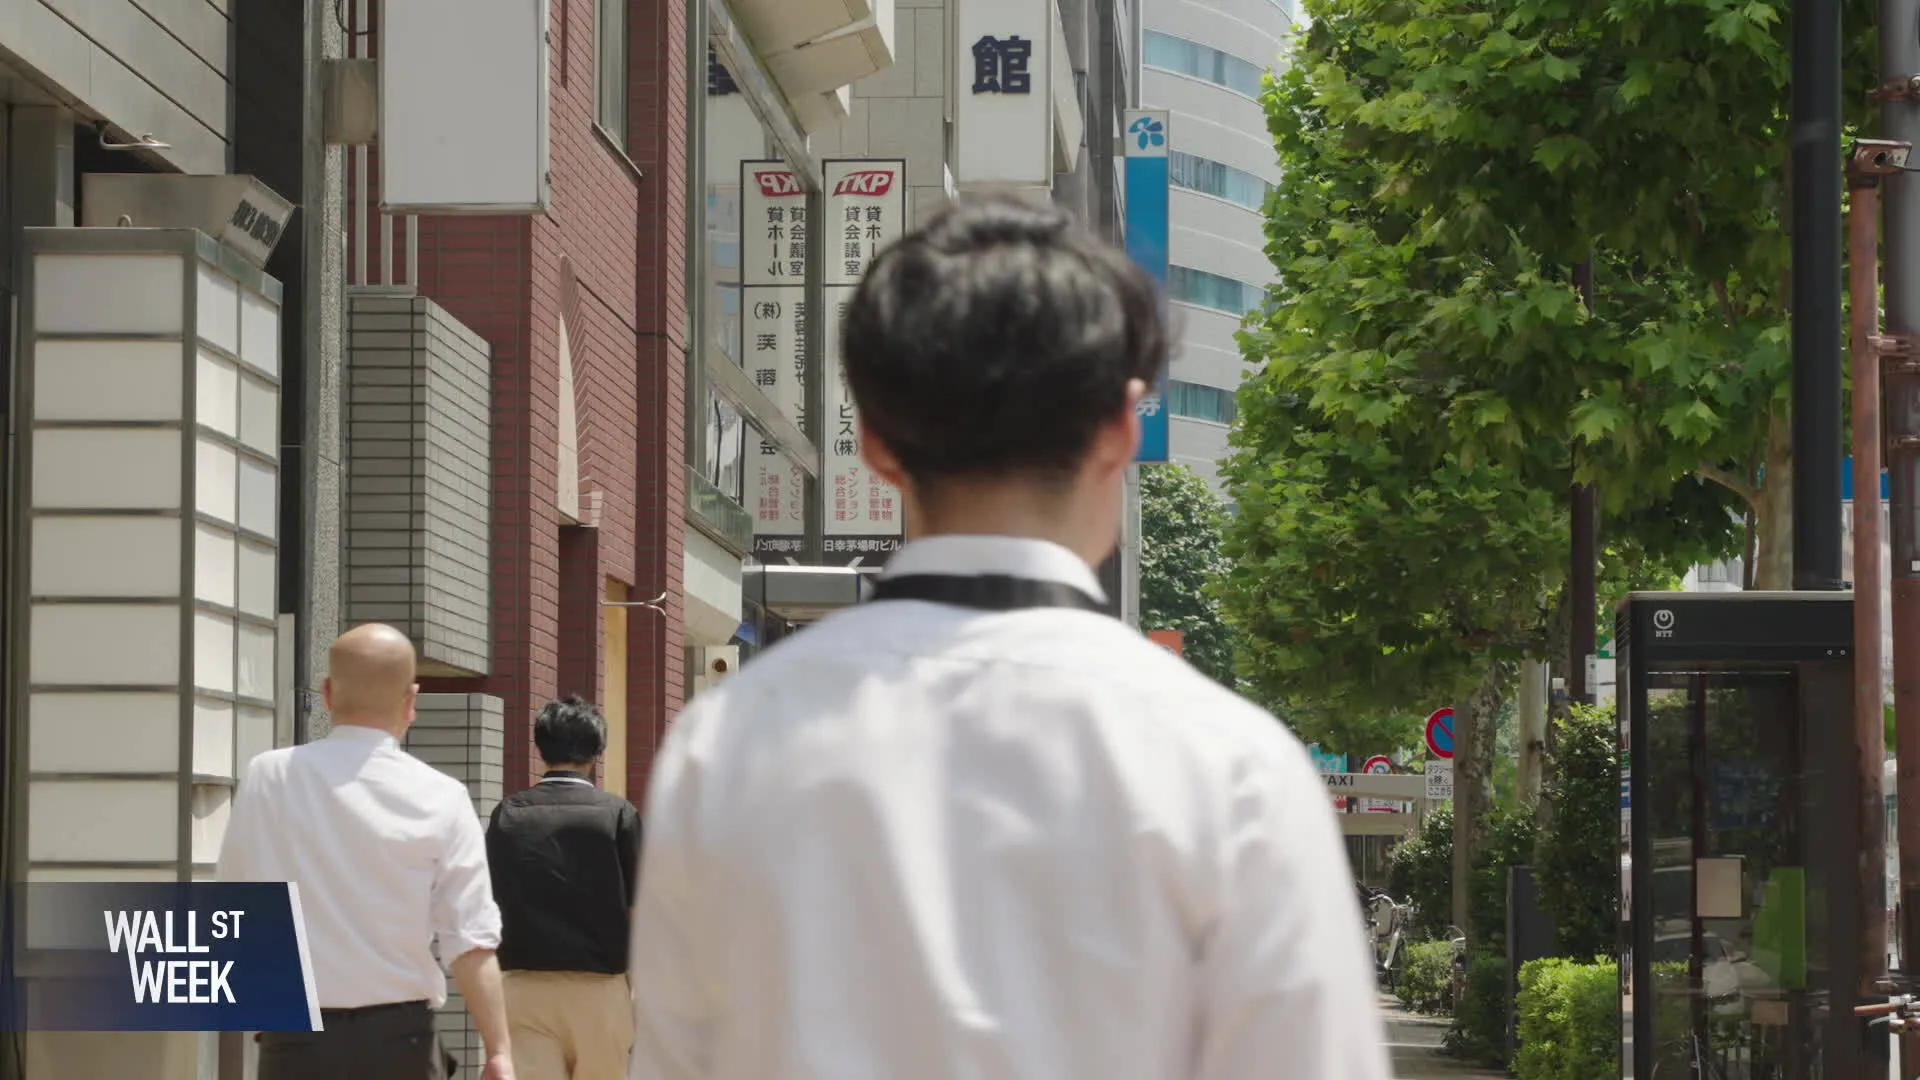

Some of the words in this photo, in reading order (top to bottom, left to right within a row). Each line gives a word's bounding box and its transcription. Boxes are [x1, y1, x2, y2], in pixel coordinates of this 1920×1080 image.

[972, 35, 1031, 94] 館
[838, 173, 891, 193] TKP
[845, 206, 861, 276] 貸会議室
[865, 206, 882, 268] 貸ホー
[834, 475, 847, 521] 総合管理
[847, 467, 860, 521] マンション
[1655, 630, 1673, 638] NTT
